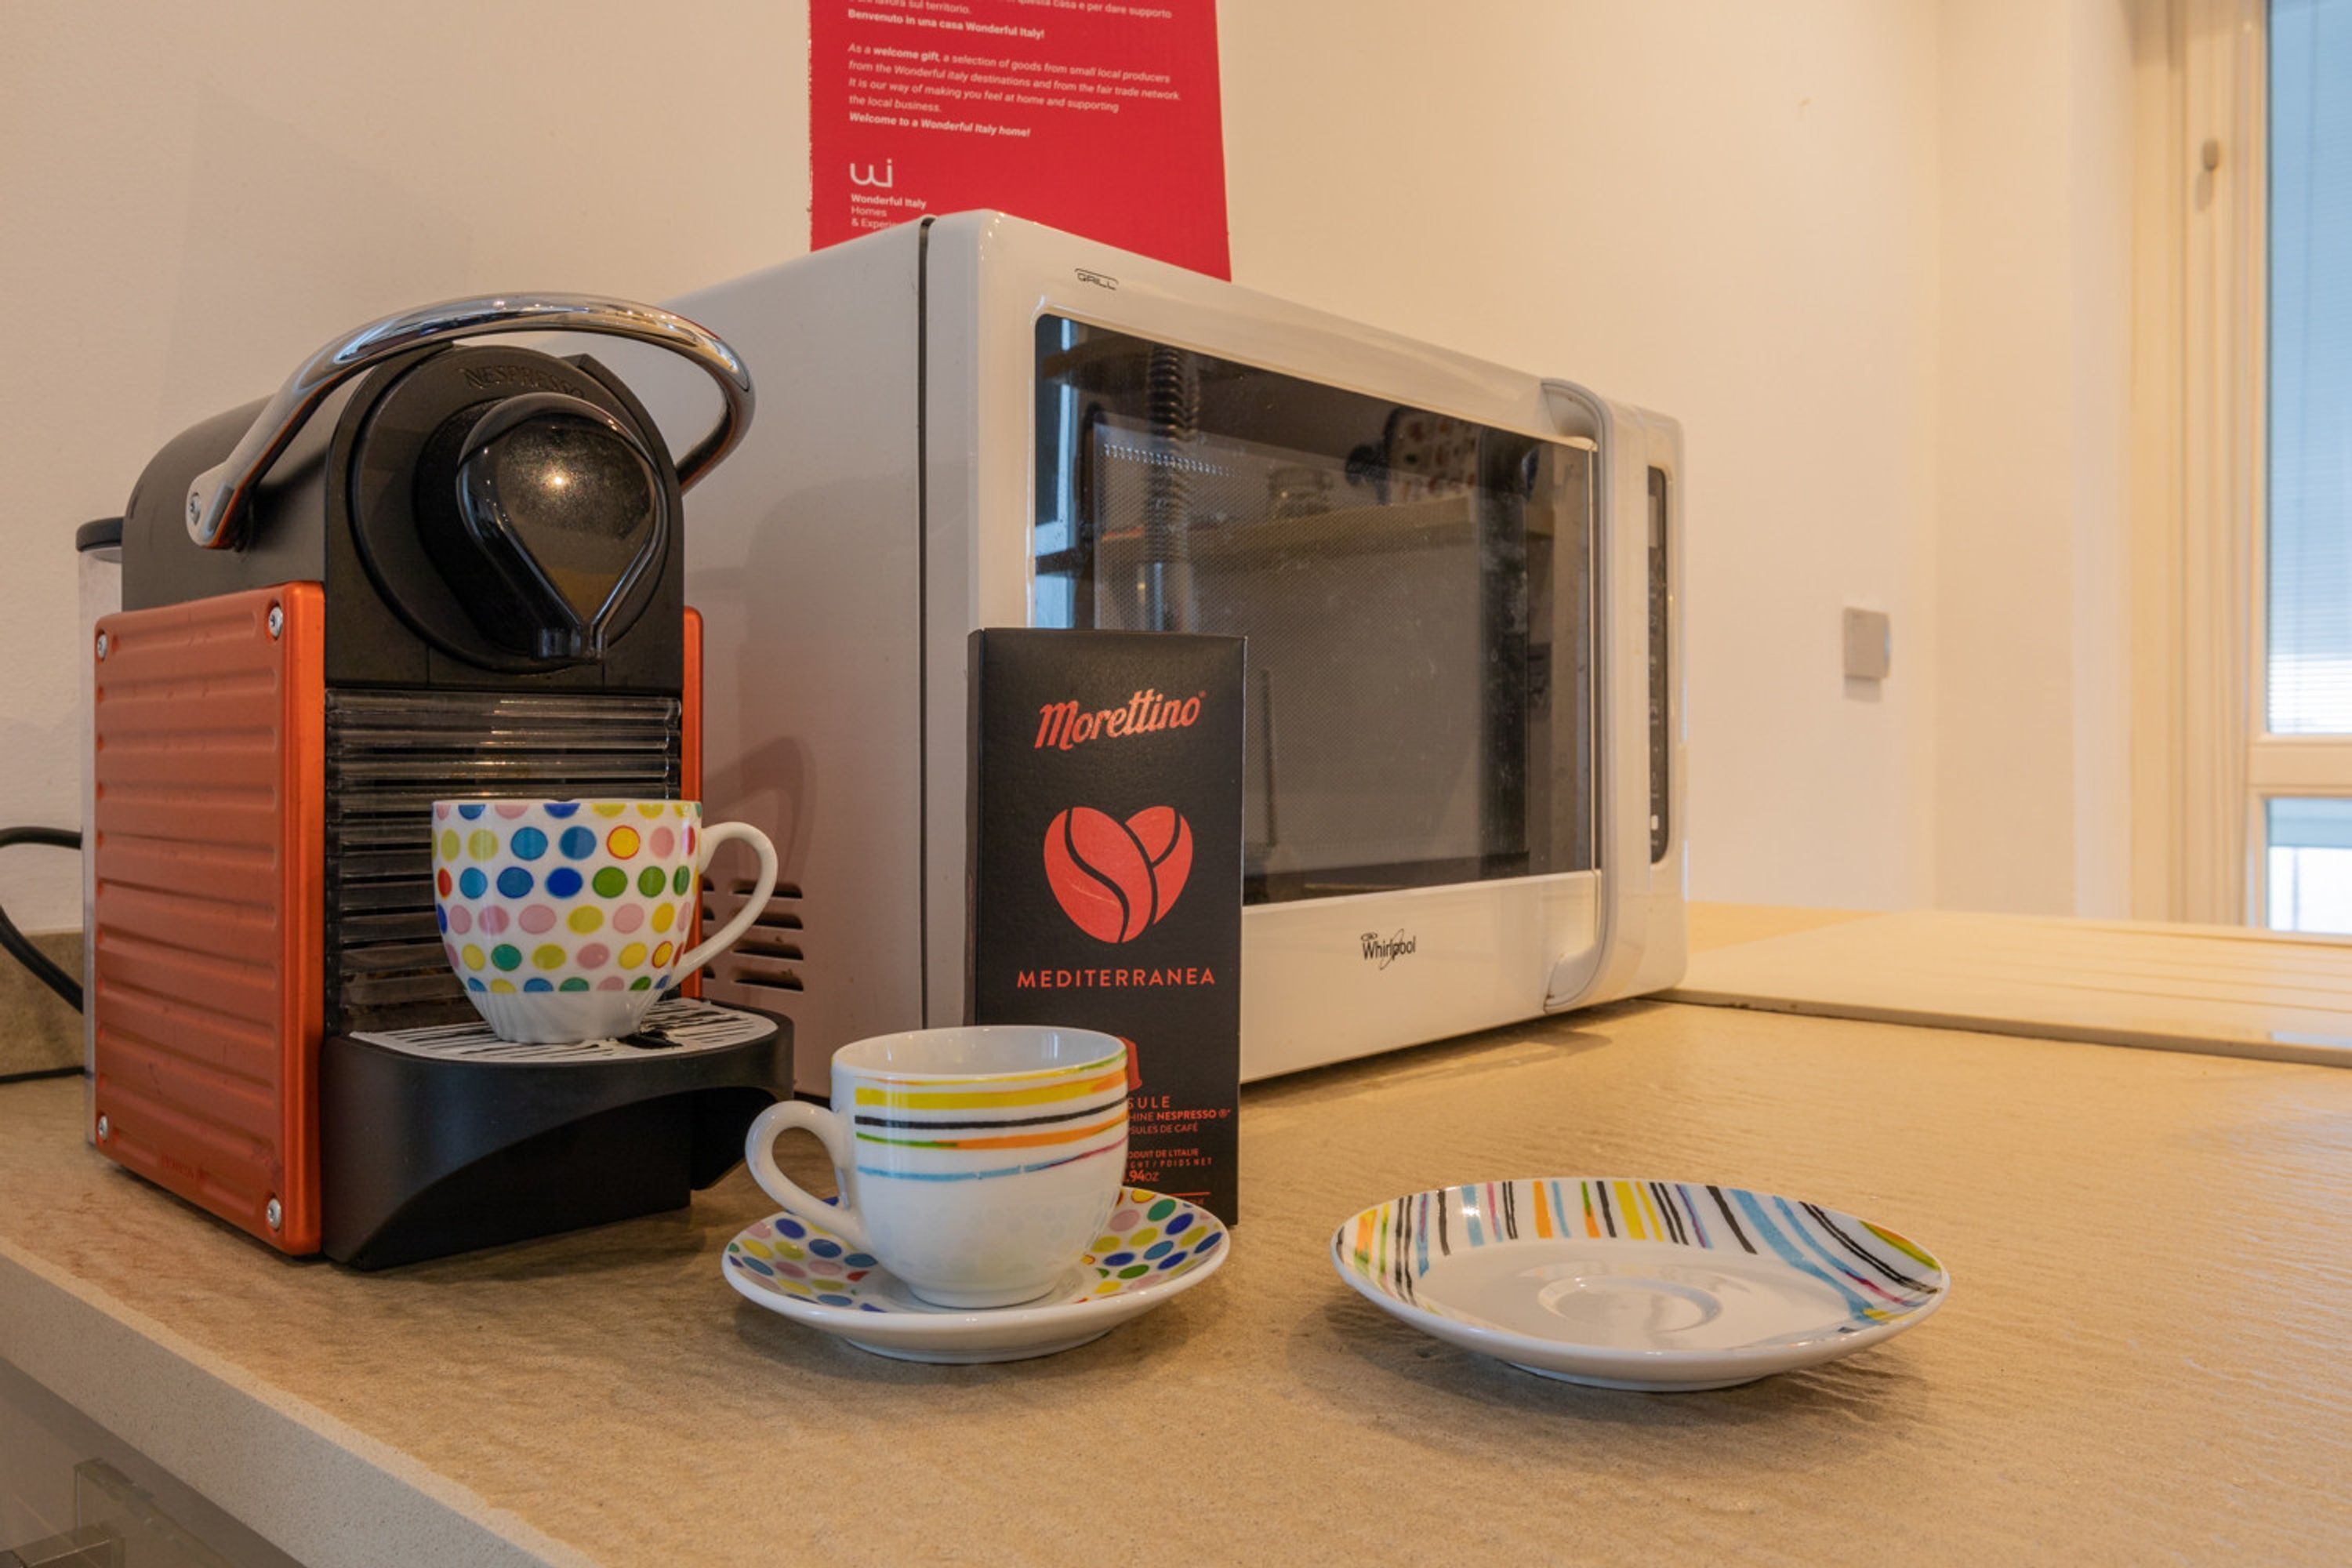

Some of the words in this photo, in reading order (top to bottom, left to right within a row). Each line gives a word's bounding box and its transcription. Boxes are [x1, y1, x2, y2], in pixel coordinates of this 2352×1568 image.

[909, 0, 924, 9] sul
[926, 2, 971, 14] territorio.
[1054, 0, 1076, 9] casa
[1087, 3, 1102, 13] per
[1105, 3, 1126, 14] dare
[1129, 8, 1172, 19] supporto
[848, 8, 903, 24] Benvenuto
[906, 15, 916, 25] in
[918, 19, 936, 28] una
[939, 20, 964, 30] casa
[966, 21, 1018, 36] Wonderful
[1020, 25, 1044, 40] Italy!
[848, 42, 861, 53] As
[873, 47, 919, 60] welcome
[952, 54, 996, 66] selection
[999, 59, 1010, 67] of
[1011, 60, 1041, 71] goods
[1044, 63, 1067, 74] from
[1069, 66, 1096, 76] small
[1098, 67, 1122, 78] local
[1123, 71, 1171, 84] producers
[848, 60, 873, 71] from
[875, 64, 892, 74] the
[894, 64, 946, 78] Wonderful
[971, 72, 1030, 87] destinations
[1033, 80, 1051, 89] and
[1054, 80, 1076, 91] from
[1079, 83, 1094, 93] the
[1096, 85, 1113, 94] fair
[1115, 86, 1138, 96] trade
[1142, 89, 1181, 100] network.
[849, 95, 866, 105] the
[867, 96, 893, 108] local
[895, 99, 941, 113] business.
[870, 82, 887, 90] our
[889, 83, 910, 94] way
[911, 85, 924, 93] of
[925, 86, 961, 100] making
[964, 91, 982, 100] you
[984, 89, 1003, 101] feel
[1004, 93, 1014, 102] at
[1016, 93, 1044, 105] home
[1047, 97, 1066, 107] and
[1067, 100, 1120, 114] supporting
[850, 111, 897, 125] Welcome
[899, 117, 909, 127] to
[921, 118, 973, 132] Wonderful
[975, 123, 997, 136] Italy
[999, 125, 1030, 137] home!
[851, 194, 903, 206] Wonderful
[905, 198, 927, 210] Italy
[851, 205, 887, 218] Homes
[851, 218, 859, 227] &
[1362, 935, 1416, 960] Whirlpool
[1017, 967, 1215, 988] MEDITERRANEA
[1156, 1109, 1217, 1121] NESPRESSO
[1160, 1124, 1173, 1134] DE
[1174, 1123, 1198, 1132] CAFÉ
